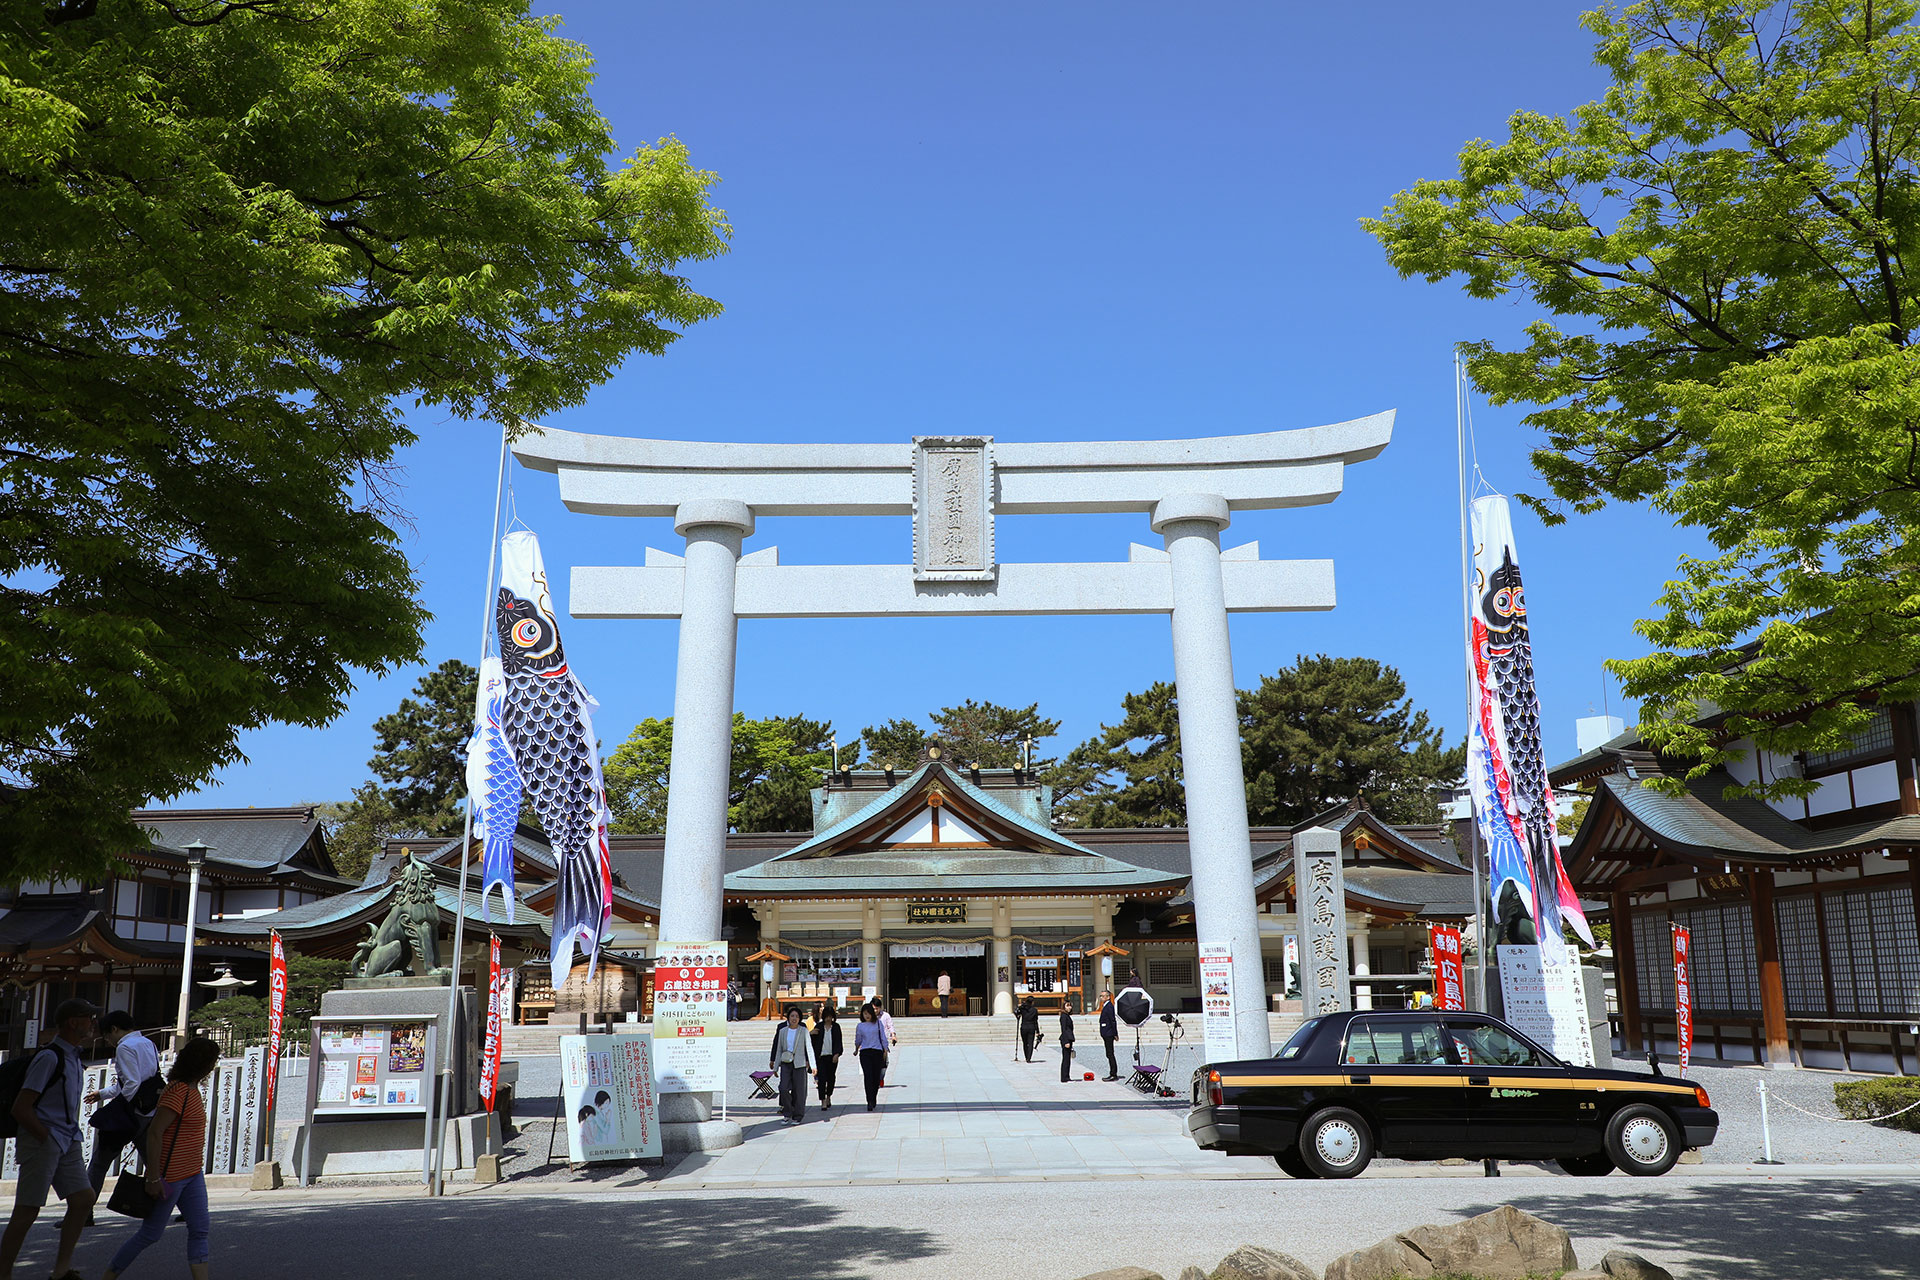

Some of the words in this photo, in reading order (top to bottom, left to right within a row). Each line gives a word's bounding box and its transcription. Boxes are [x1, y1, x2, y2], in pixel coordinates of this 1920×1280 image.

[664, 979, 720, 990] 広島泣き相撲
[624, 1041, 637, 1112] おまつりしましょう
[640, 1041, 654, 1121] みんなの幸せを願って
